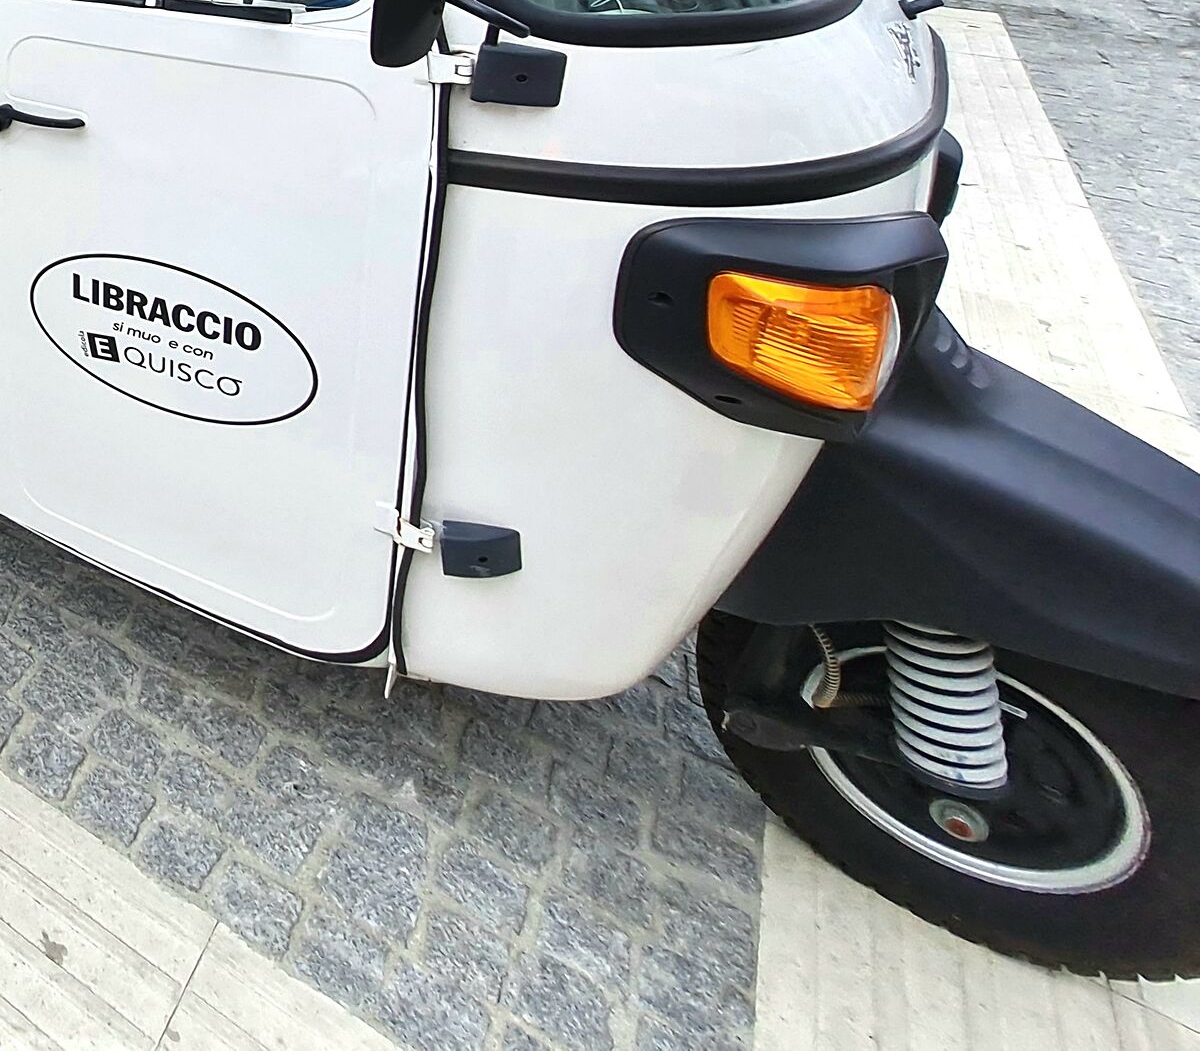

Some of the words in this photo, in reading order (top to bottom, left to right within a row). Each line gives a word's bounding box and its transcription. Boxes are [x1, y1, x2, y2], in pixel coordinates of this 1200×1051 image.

[72, 272, 262, 351] LIBRACCIO
[112, 321, 124, 332] si
[183, 343, 214, 360] con
